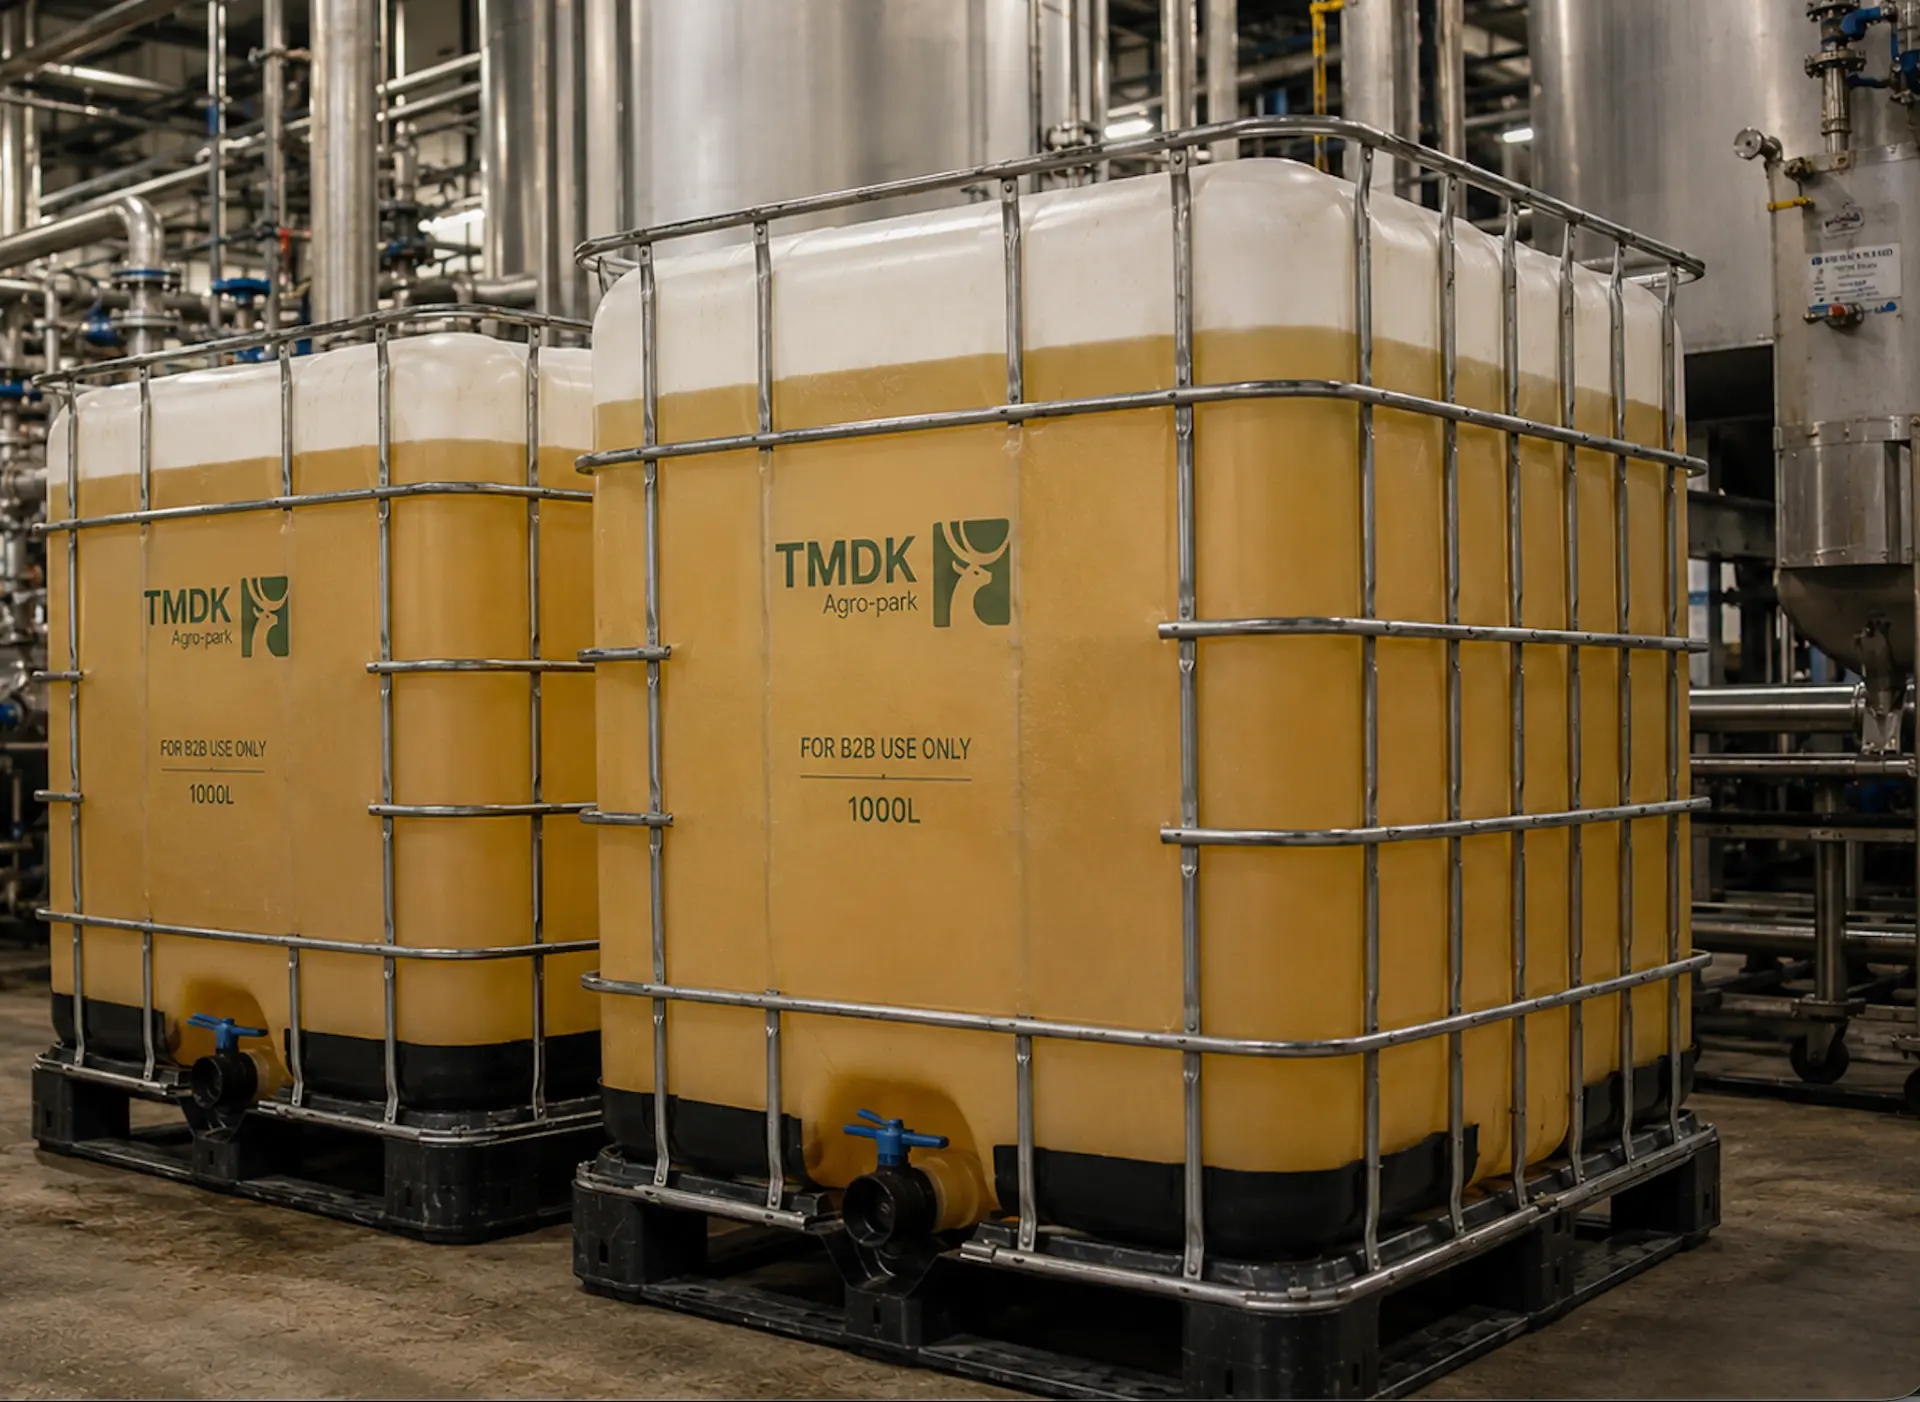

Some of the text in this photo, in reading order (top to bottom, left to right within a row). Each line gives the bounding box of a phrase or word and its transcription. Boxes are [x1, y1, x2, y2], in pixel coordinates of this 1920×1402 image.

[775, 536, 918, 588] TMDK
[144, 587, 232, 626] TMDK
[823, 590, 918, 619] Agro-park
[160, 739, 267, 758] FOR B2B USE ONLY
[800, 737, 972, 761] FOR B2B USE ONLY
[190, 784, 235, 805] 1000L
[848, 796, 921, 824] 1000L
